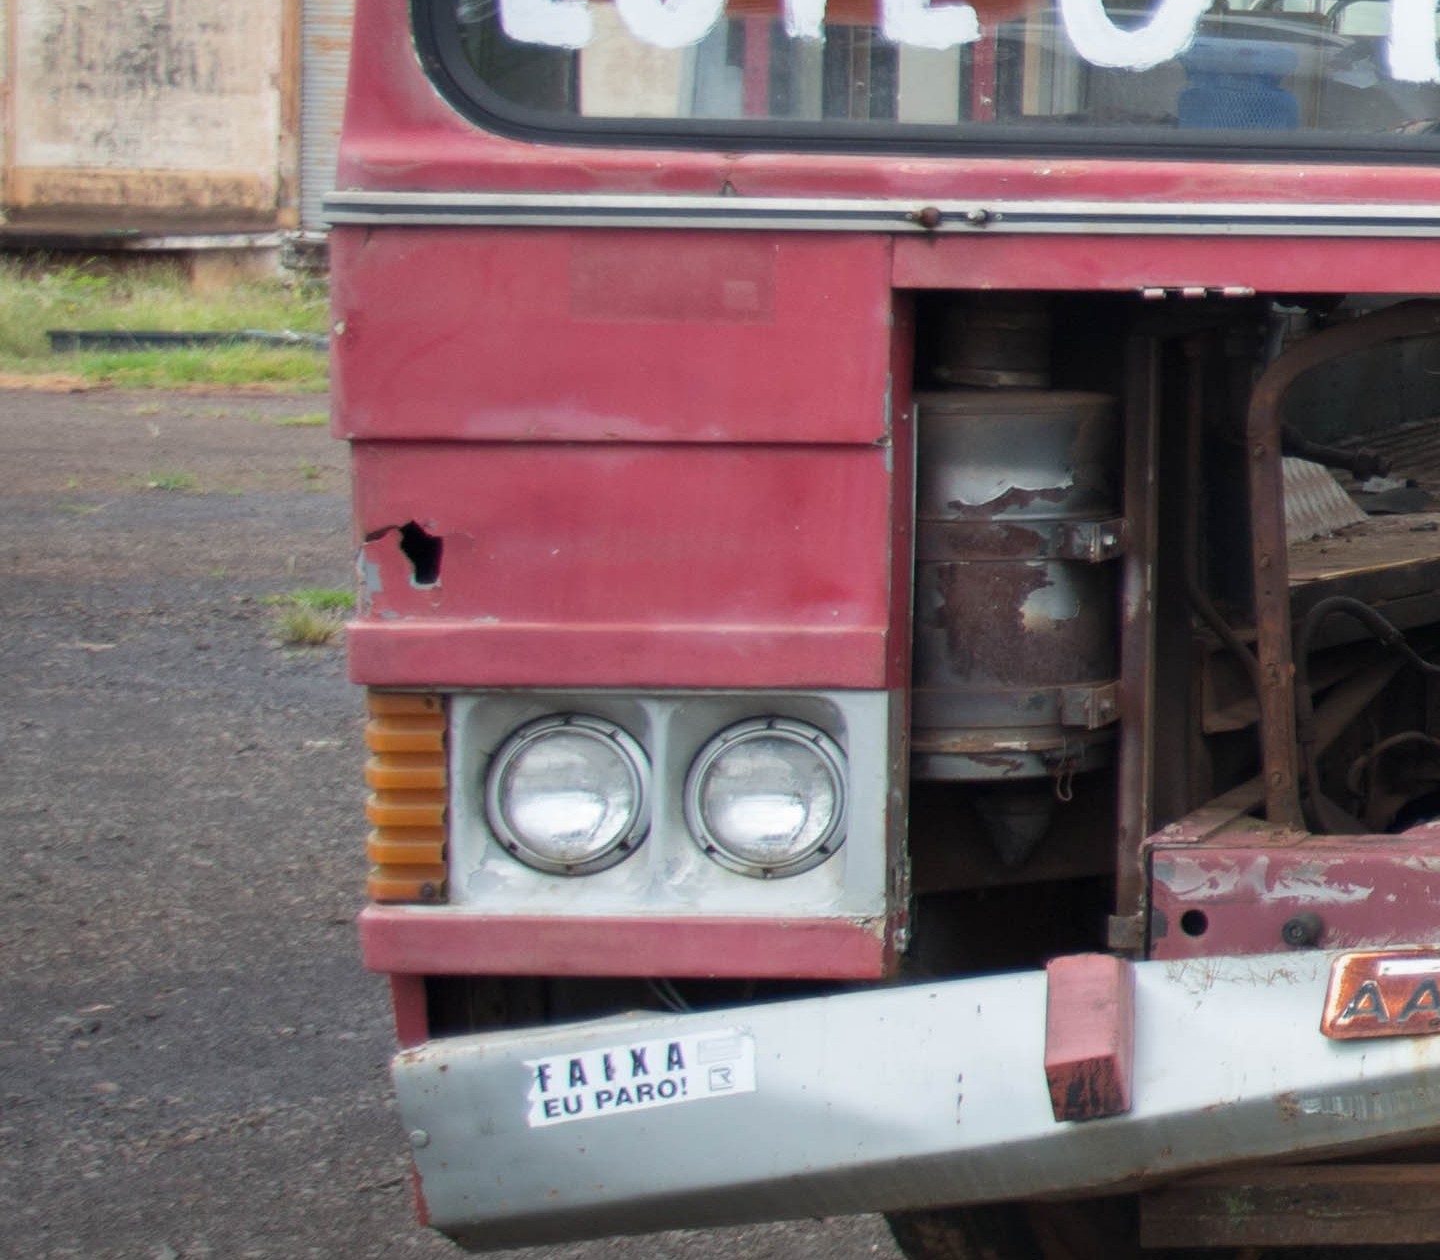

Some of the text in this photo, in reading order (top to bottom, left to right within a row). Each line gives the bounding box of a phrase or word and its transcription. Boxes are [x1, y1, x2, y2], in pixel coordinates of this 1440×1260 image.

[536, 1041, 686, 1093] FAIXA
[543, 1093, 584, 1119] EU
[595, 1076, 688, 1110] PARO!
